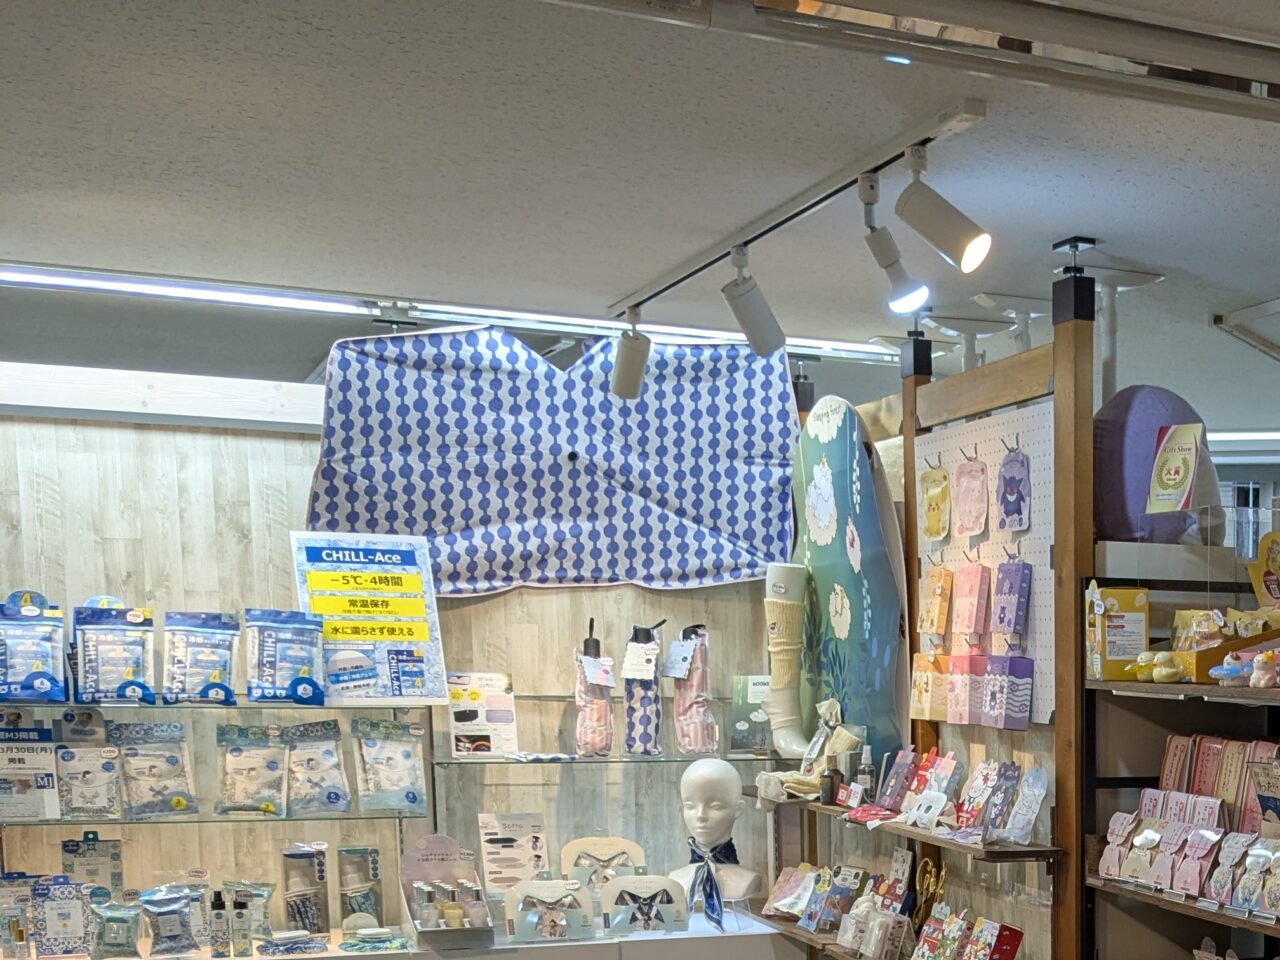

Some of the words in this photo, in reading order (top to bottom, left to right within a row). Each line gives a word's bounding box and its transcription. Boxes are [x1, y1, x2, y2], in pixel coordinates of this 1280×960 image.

[321, 550, 401, 563] CHILL-Ace
[348, 599, 390, 609] 常温保存
[331, 626, 415, 637] 水に濡らさず使える
[8, 757, 26, 765] 掲載
[37, 777, 53, 789] MJ
